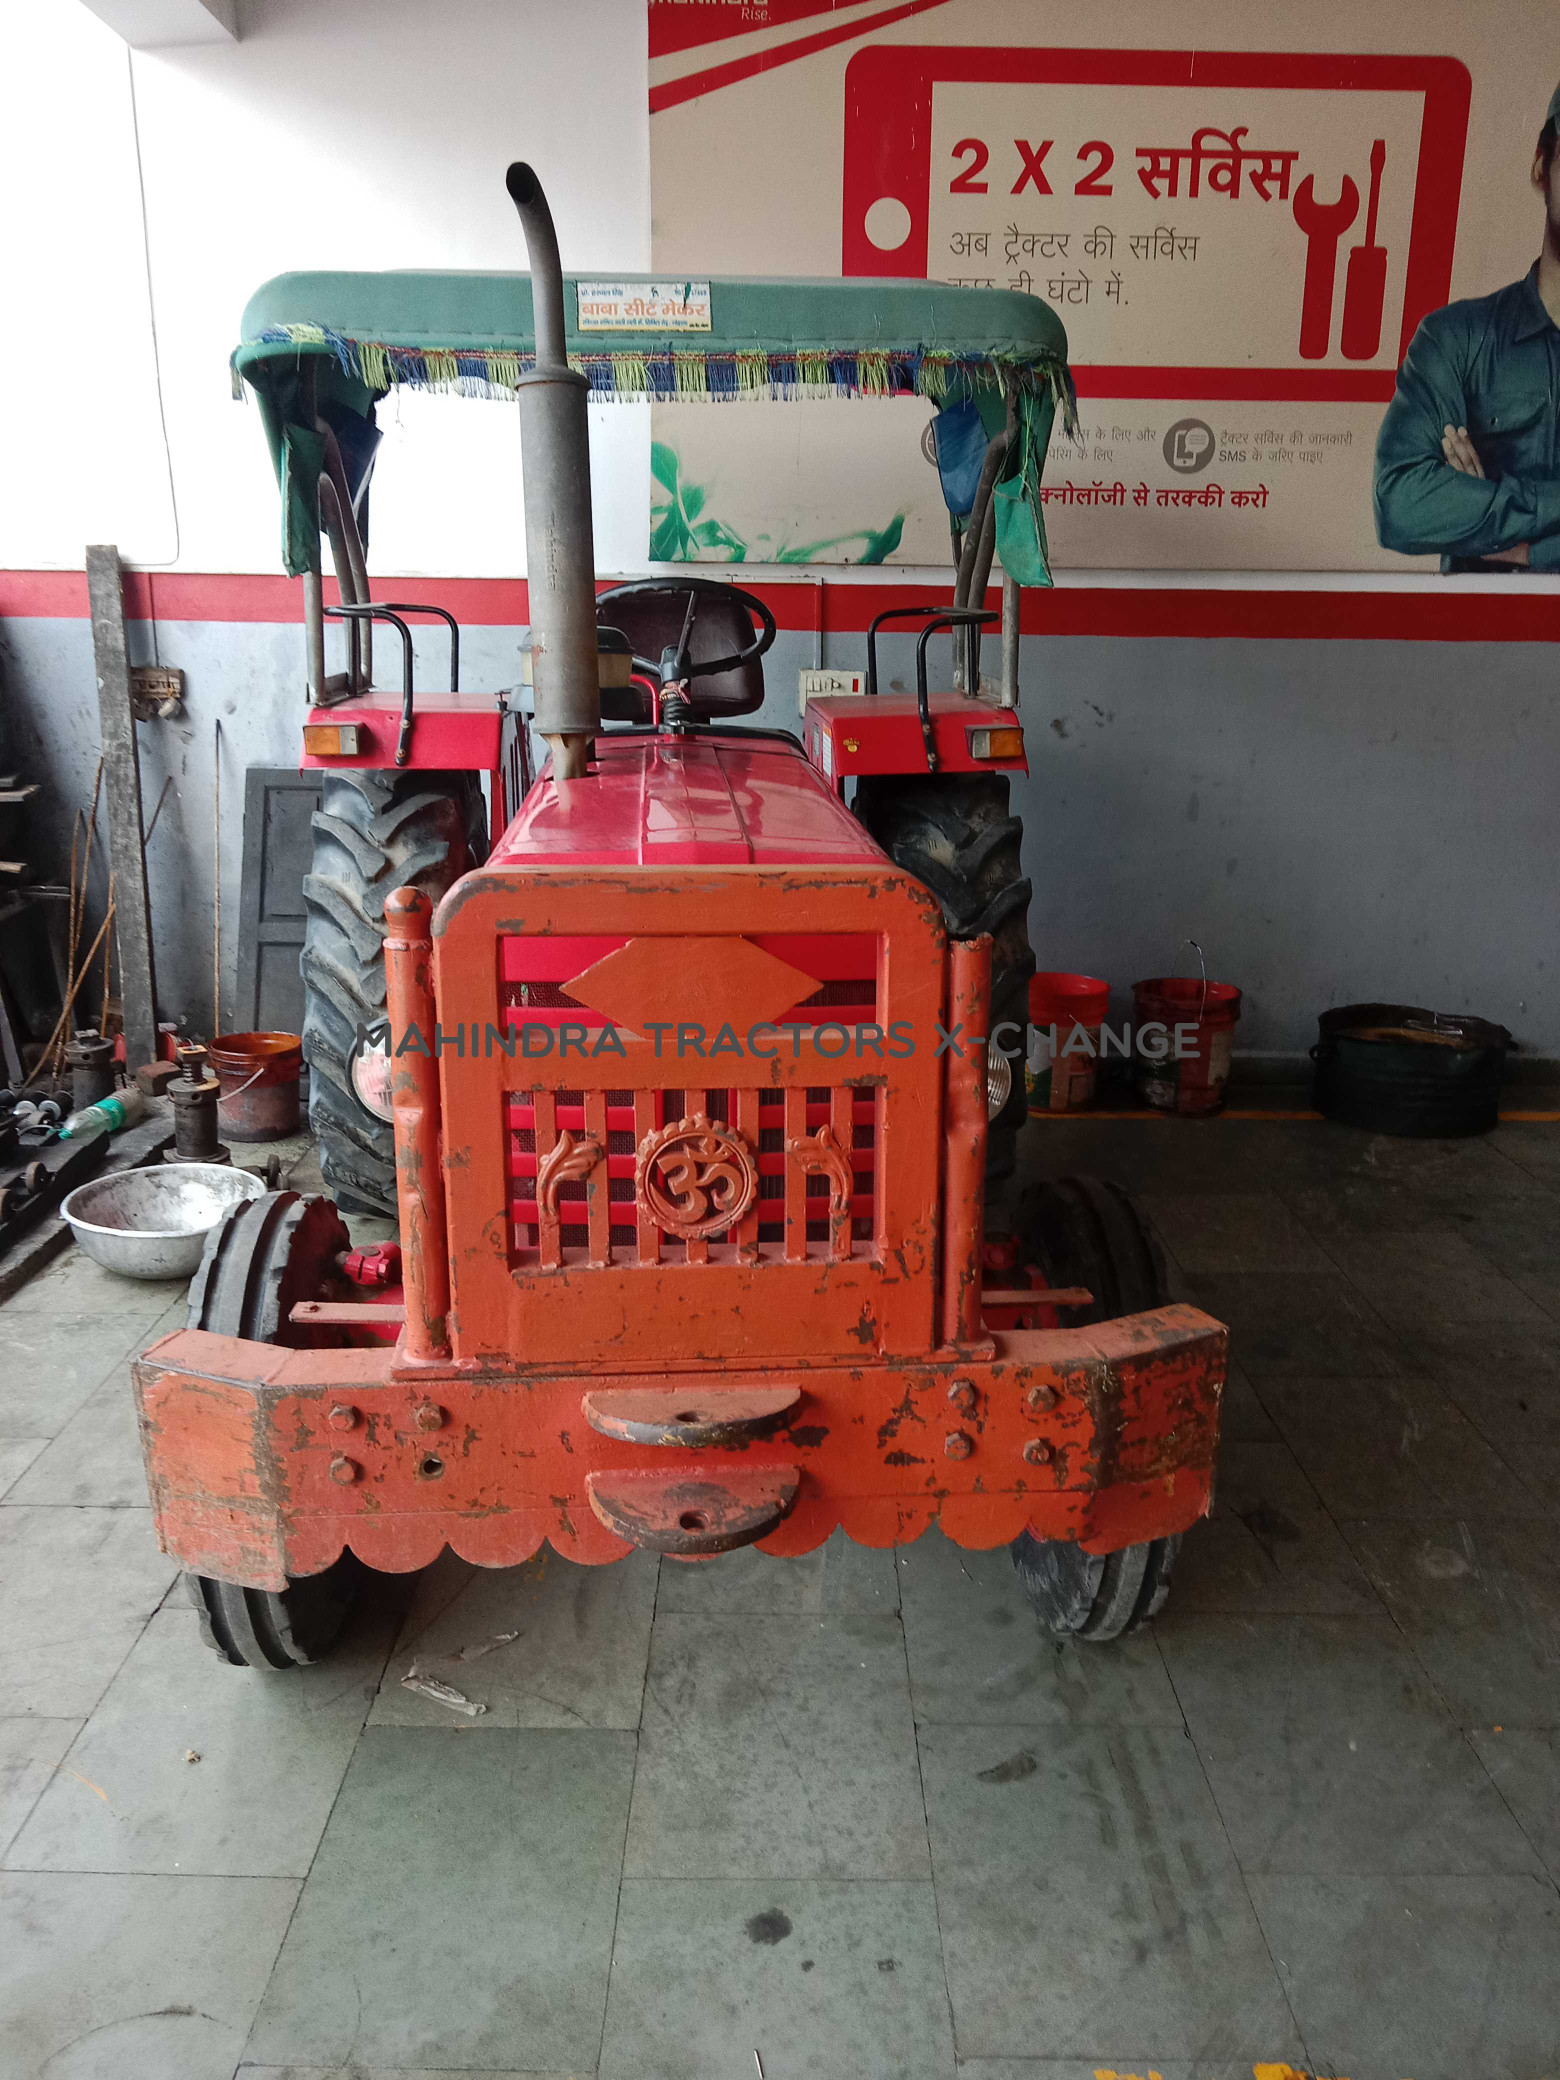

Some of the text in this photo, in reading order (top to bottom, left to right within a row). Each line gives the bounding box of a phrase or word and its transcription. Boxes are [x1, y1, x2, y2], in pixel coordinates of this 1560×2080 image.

[741, 7, 772, 21] Rise.
[949, 126, 1300, 203] 2 X 2 सर्विस
[949, 222, 1201, 265] अब ट्रैक्टर की सर्विस
[1047, 269, 1093, 305] घंटो
[1104, 269, 1130, 305] में.
[623, 297, 658, 316] सीट
[1095, 426, 1107, 442] के
[1111, 425, 1132, 442] लिए
[1136, 426, 1157, 442] और
[1290, 430, 1304, 446] की
[1308, 430, 1353, 447] जानकारी
[1093, 446, 1114, 463] लिए
[1219, 449, 1247, 463] SMS
[1251, 446, 1263, 463] के
[1040, 480, 1270, 509] क्नोलॉजी से तरक्की करो
